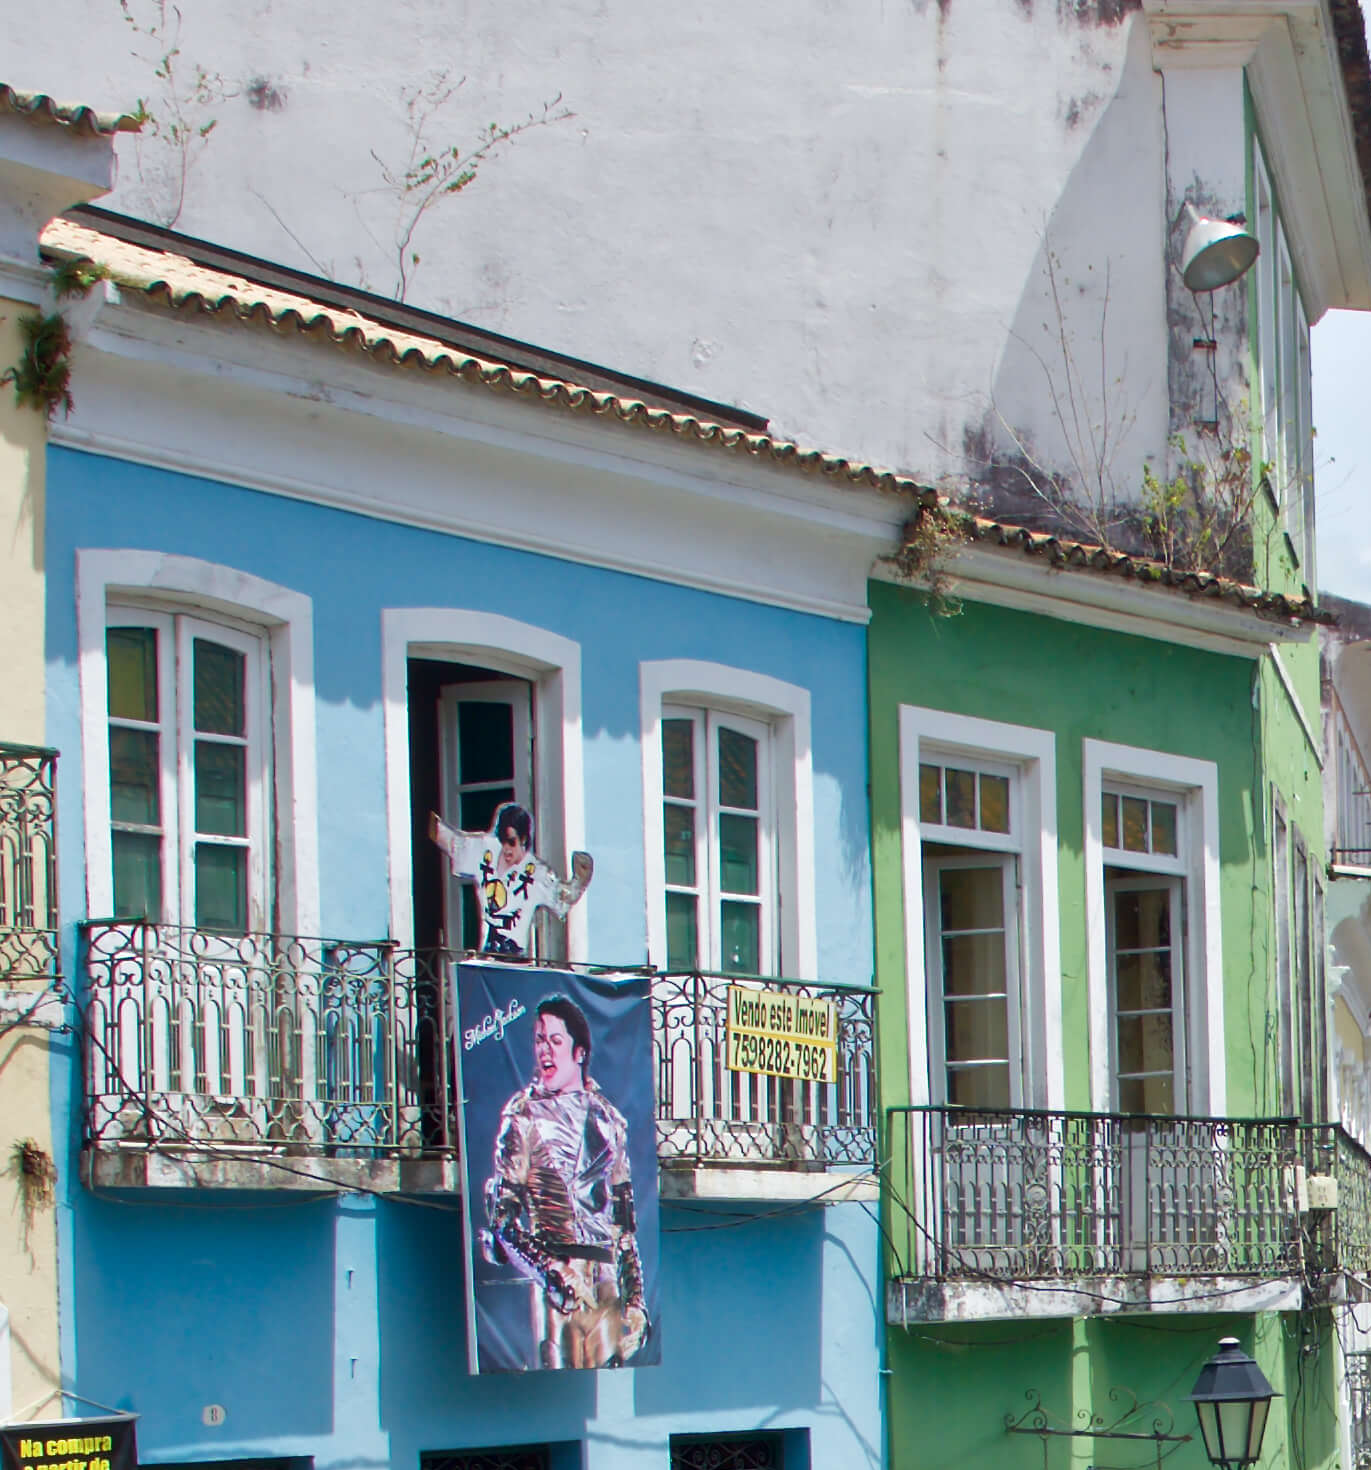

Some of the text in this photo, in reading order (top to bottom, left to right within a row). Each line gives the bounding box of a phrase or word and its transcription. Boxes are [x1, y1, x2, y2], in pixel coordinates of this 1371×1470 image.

[735, 990, 830, 1037] Vendo este Imóvel
[20, 1436, 112, 1458] Na compra
